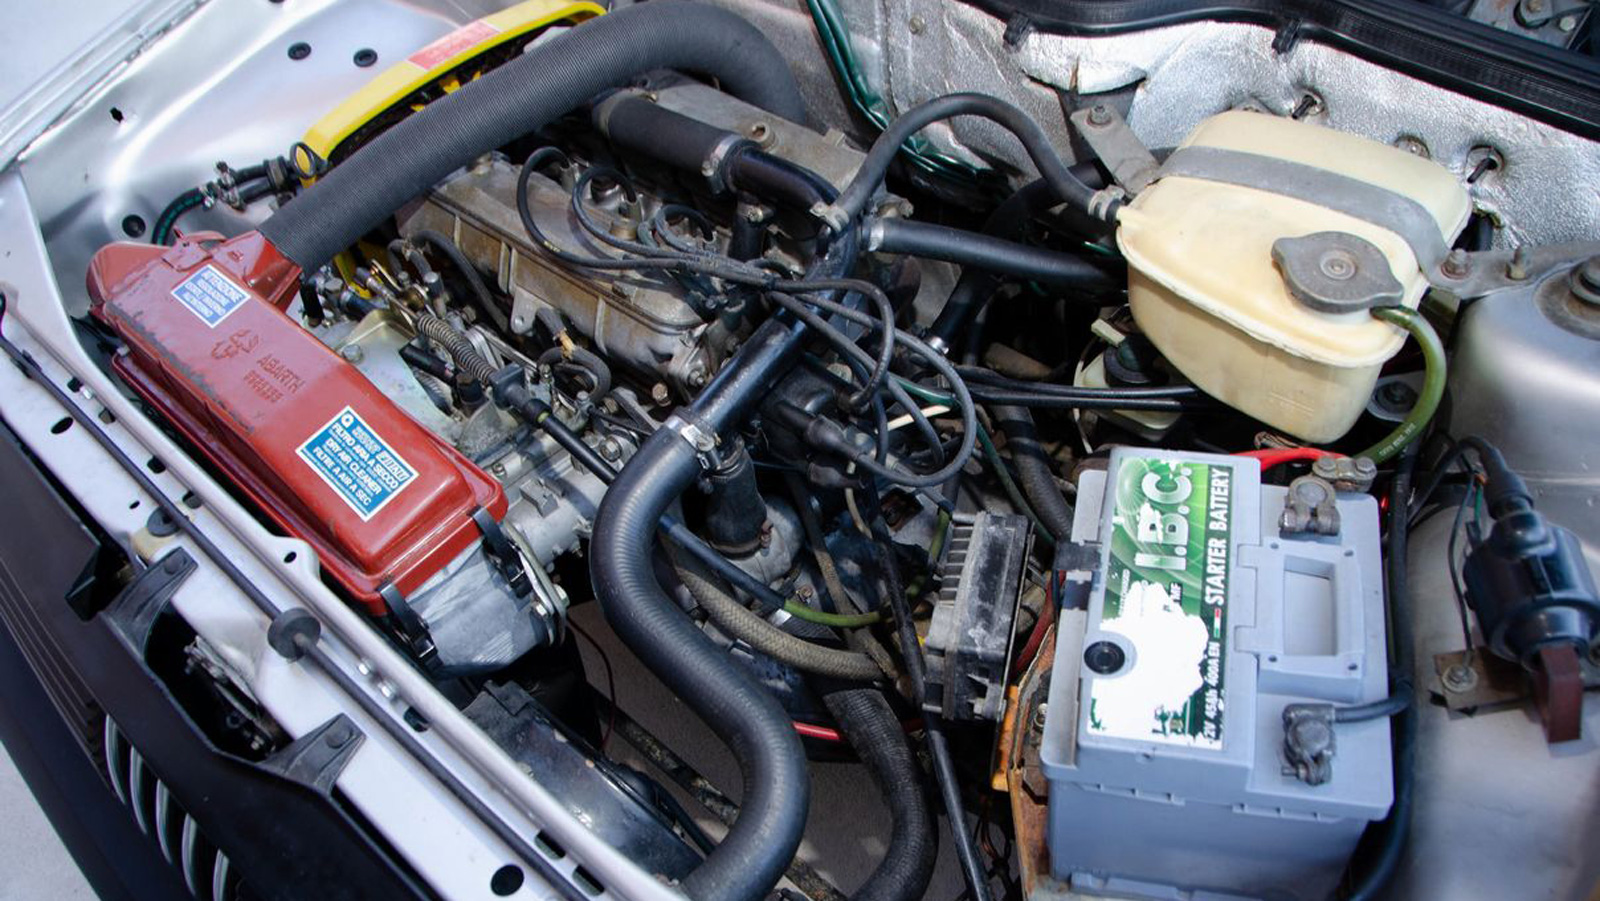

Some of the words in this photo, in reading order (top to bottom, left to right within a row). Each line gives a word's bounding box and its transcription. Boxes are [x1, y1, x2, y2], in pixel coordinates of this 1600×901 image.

[256, 353, 306, 394] ABARTH
[313, 446, 336, 469] FILTRE
[332, 466, 341, 475] A
[338, 472, 353, 486] AIR
[349, 484, 358, 492] A
[355, 489, 371, 506] SEC
[326, 437, 340, 453] DRY
[338, 451, 352, 465] AIR
[350, 461, 382, 494] CLEANER
[332, 422, 356, 446] FILTRO
[353, 444, 370, 462] ARIA
[368, 458, 376, 467] A
[373, 463, 399, 489] SECCO
[1134, 467, 1193, 570] I.B.C.
[1208, 468, 1230, 531] BATTERY
[1205, 537, 1227, 605] STARTER
[1205, 658, 1219, 687] 400A
[1208, 641, 1221, 656] EN
[1203, 720, 1217, 739] 2V
[1205, 689, 1218, 719] 45Ah
